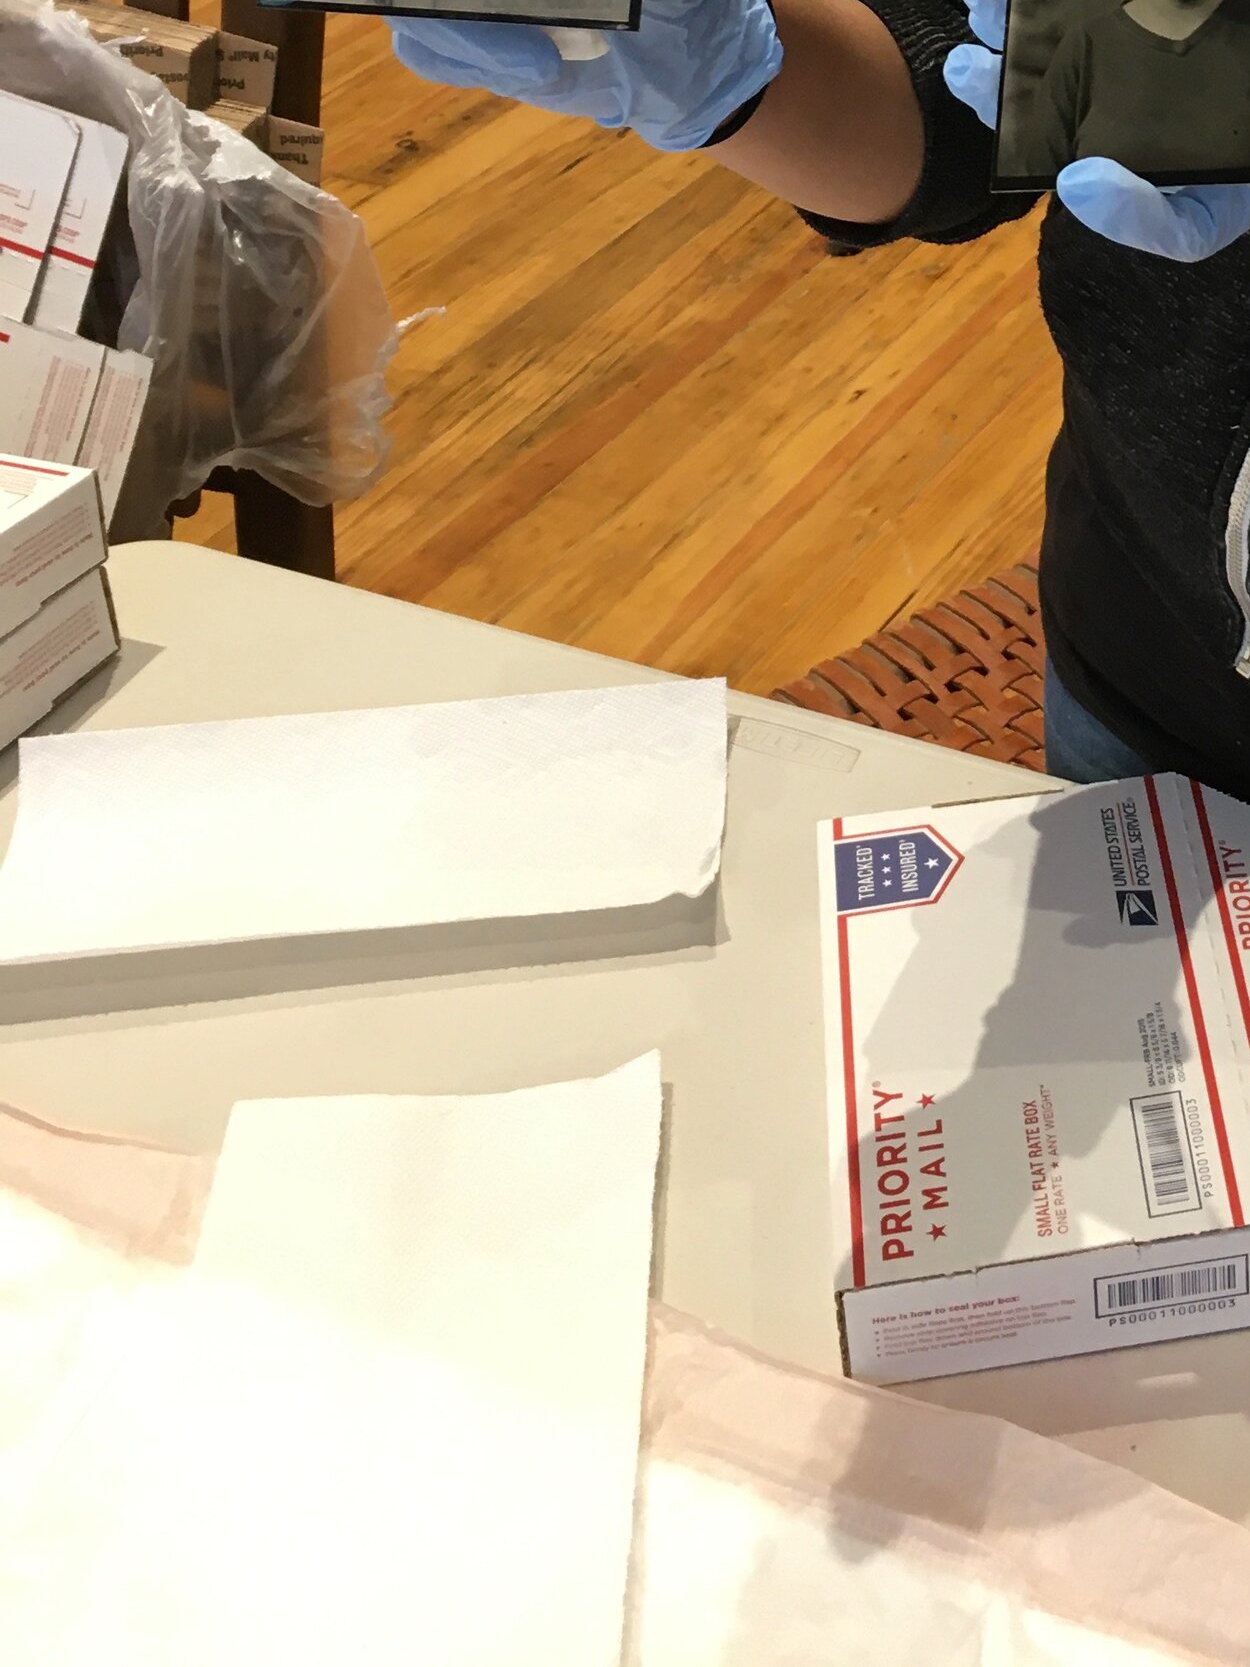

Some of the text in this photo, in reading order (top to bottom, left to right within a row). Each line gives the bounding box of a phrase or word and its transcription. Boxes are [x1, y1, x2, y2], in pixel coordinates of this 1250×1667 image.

[1100, 807, 1127, 886] UNITED STATES
[1130, 844, 1150, 885] POSTAL
[1045, 1132, 1057, 1156] ANY
[916, 1118, 948, 1210] MAIL
[1022, 1099, 1052, 1237] SMALL FLAT RATE BOX
[1051, 1174, 1064, 1205] RATE
[1055, 1207, 1068, 1234] ONE
[910, 1308, 932, 1318] how
[934, 1306, 945, 1314] to
[1109, 1297, 1235, 1326] PS00011000003
